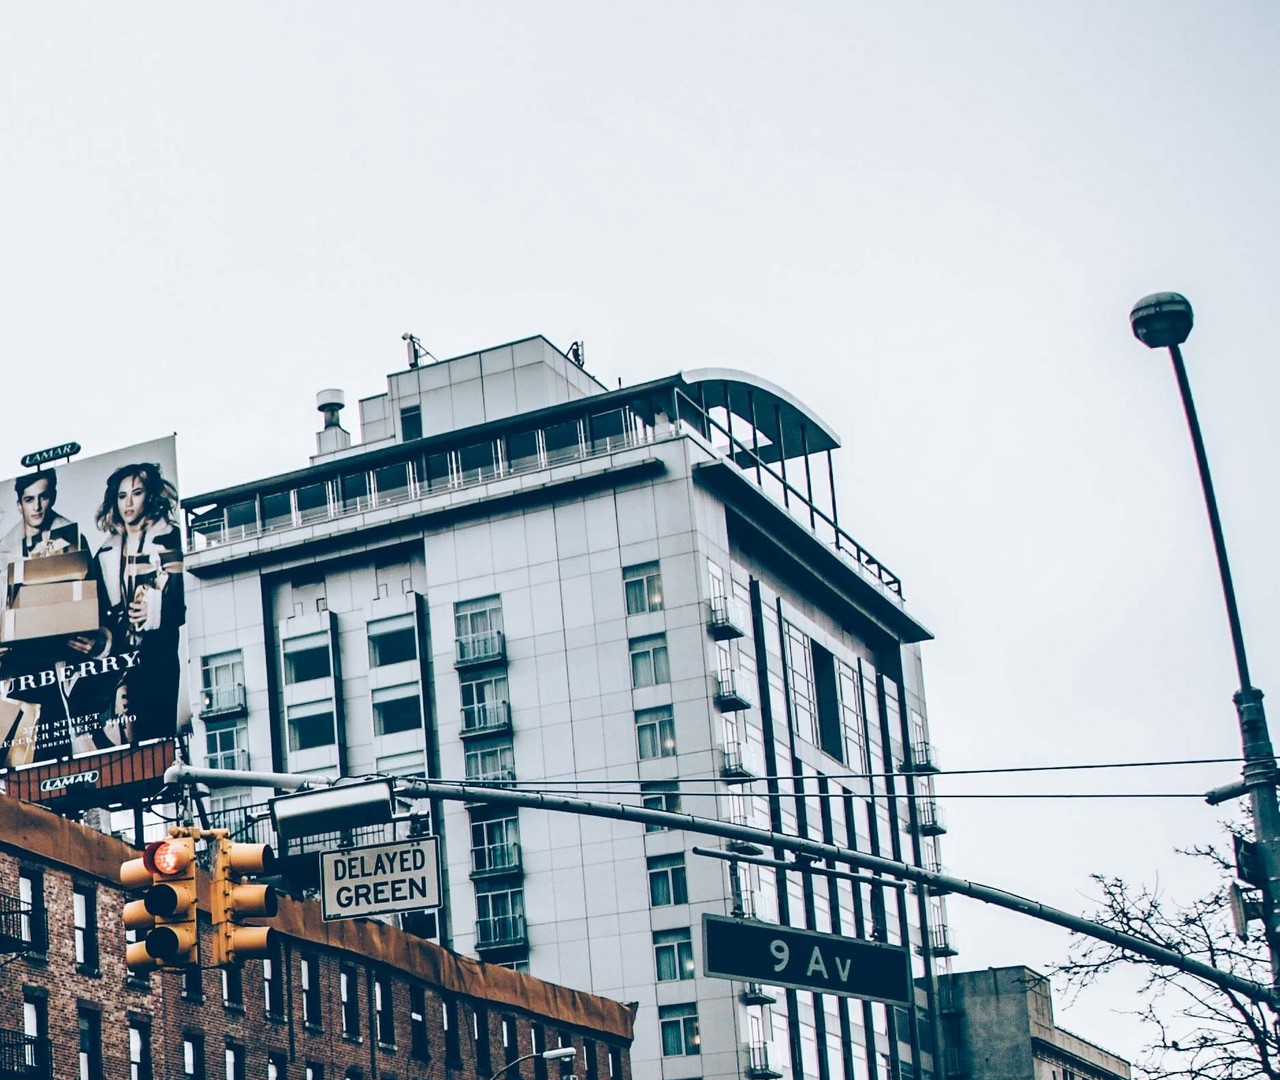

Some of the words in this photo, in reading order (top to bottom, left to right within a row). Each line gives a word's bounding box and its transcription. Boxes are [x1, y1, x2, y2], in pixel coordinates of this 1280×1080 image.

[25, 445, 71, 465] LAMAR
[45, 772, 93, 790] LAMAR
[333, 848, 426, 881] DELAYED
[336, 876, 427, 908] GREEN
[770, 939, 790, 972] 9
[806, 946, 852, 982] Av
